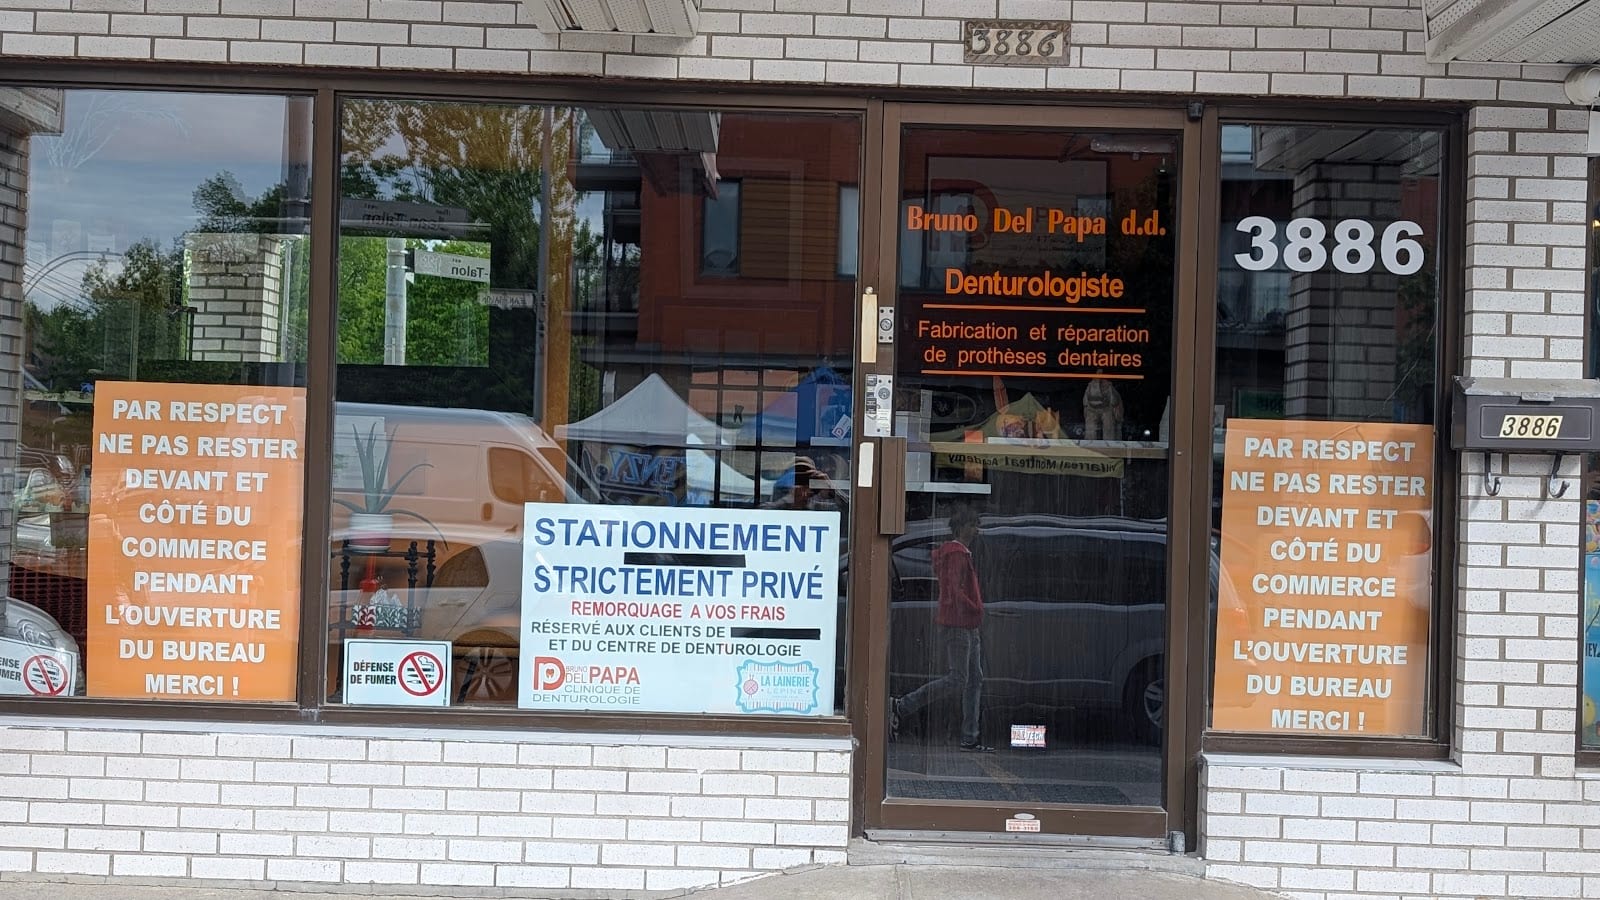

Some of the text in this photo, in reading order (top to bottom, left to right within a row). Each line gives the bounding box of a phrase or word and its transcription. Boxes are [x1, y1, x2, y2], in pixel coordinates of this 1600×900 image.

[971, 29, 1061, 57] 3886
[907, 206, 978, 232] Bruno
[993, 207, 1033, 234] Del
[1048, 209, 1106, 243] Papa
[1121, 209, 1166, 236] d.d.
[1233, 215, 1426, 276] 3886
[945, 268, 1124, 304] Denturologiste
[918, 320, 1149, 345] Fabrication et réparation
[924, 346, 1142, 367] de prothèses dentaires
[113, 400, 287, 424] PAR RESPECT
[1502, 415, 1560, 437] 3886
[99, 433, 298, 459] NE PAS RESTER
[1245, 437, 1416, 462] PAR RESPECT
[126, 468, 268, 492] DEVANT ET
[1230, 471, 1426, 496] NE PAS RESTER
[139, 500, 251, 526] CÔTÉ DU
[1257, 506, 1398, 529] DEVANT ET
[534, 517, 829, 553] STATIONNEMENT
[122, 537, 267, 561] COMMERCE
[1270, 536, 1381, 563] CÔTÉ DU
[134, 571, 253, 595] PENDANT
[533, 564, 823, 600] STRICTEMENT PRIVÉ
[1252, 573, 1396, 598] COMMERCE
[105, 605, 281, 629] L'OUVERTURE
[571, 601, 786, 621] REMORQUAGE A VOS FRAIS
[1264, 607, 1383, 631] PENDANT
[531, 619, 726, 639] RÉSERVÉ AUX CLIENTS DE
[119, 639, 266, 663] DU BUREAU
[549, 639, 801, 657] ET DU CENTRE DE DENTUROLOGIE
[1234, 640, 1408, 665] L'OUVERTURE
[353, 659, 394, 673] DÉFENSE
[565, 666, 641, 685] DEL PAPA
[145, 674, 240, 696] MERCI !
[350, 674, 397, 685] DE FUMER
[564, 684, 640, 695] CLINIQUE DE
[761, 675, 810, 688] LA LAINERIE
[1247, 675, 1392, 699] DU BUREAU
[532, 693, 640, 705] DENTUROLOGIE
[1271, 709, 1366, 731] MERCI !
